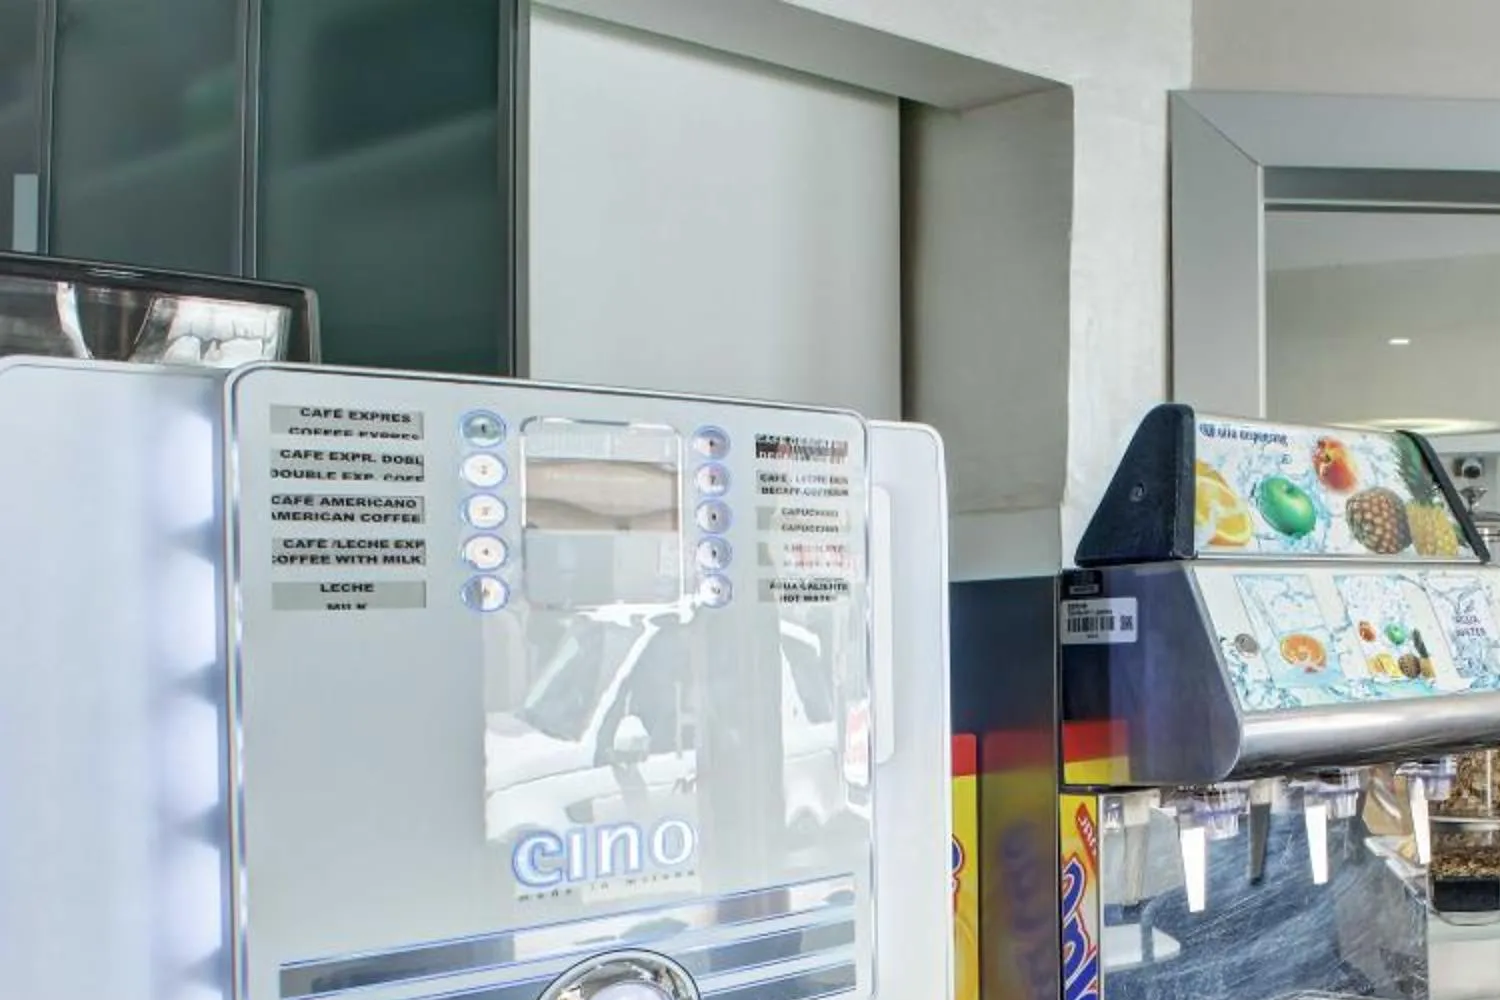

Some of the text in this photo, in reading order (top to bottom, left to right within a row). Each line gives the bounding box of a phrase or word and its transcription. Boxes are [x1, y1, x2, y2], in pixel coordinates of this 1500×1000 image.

[320, 496, 417, 509] AMERICANO
[360, 513, 421, 523] COFFEE
[335, 554, 378, 565] WITH
[383, 555, 421, 565] MILK
[319, 582, 375, 593] LECHE
[513, 820, 697, 888] cino
